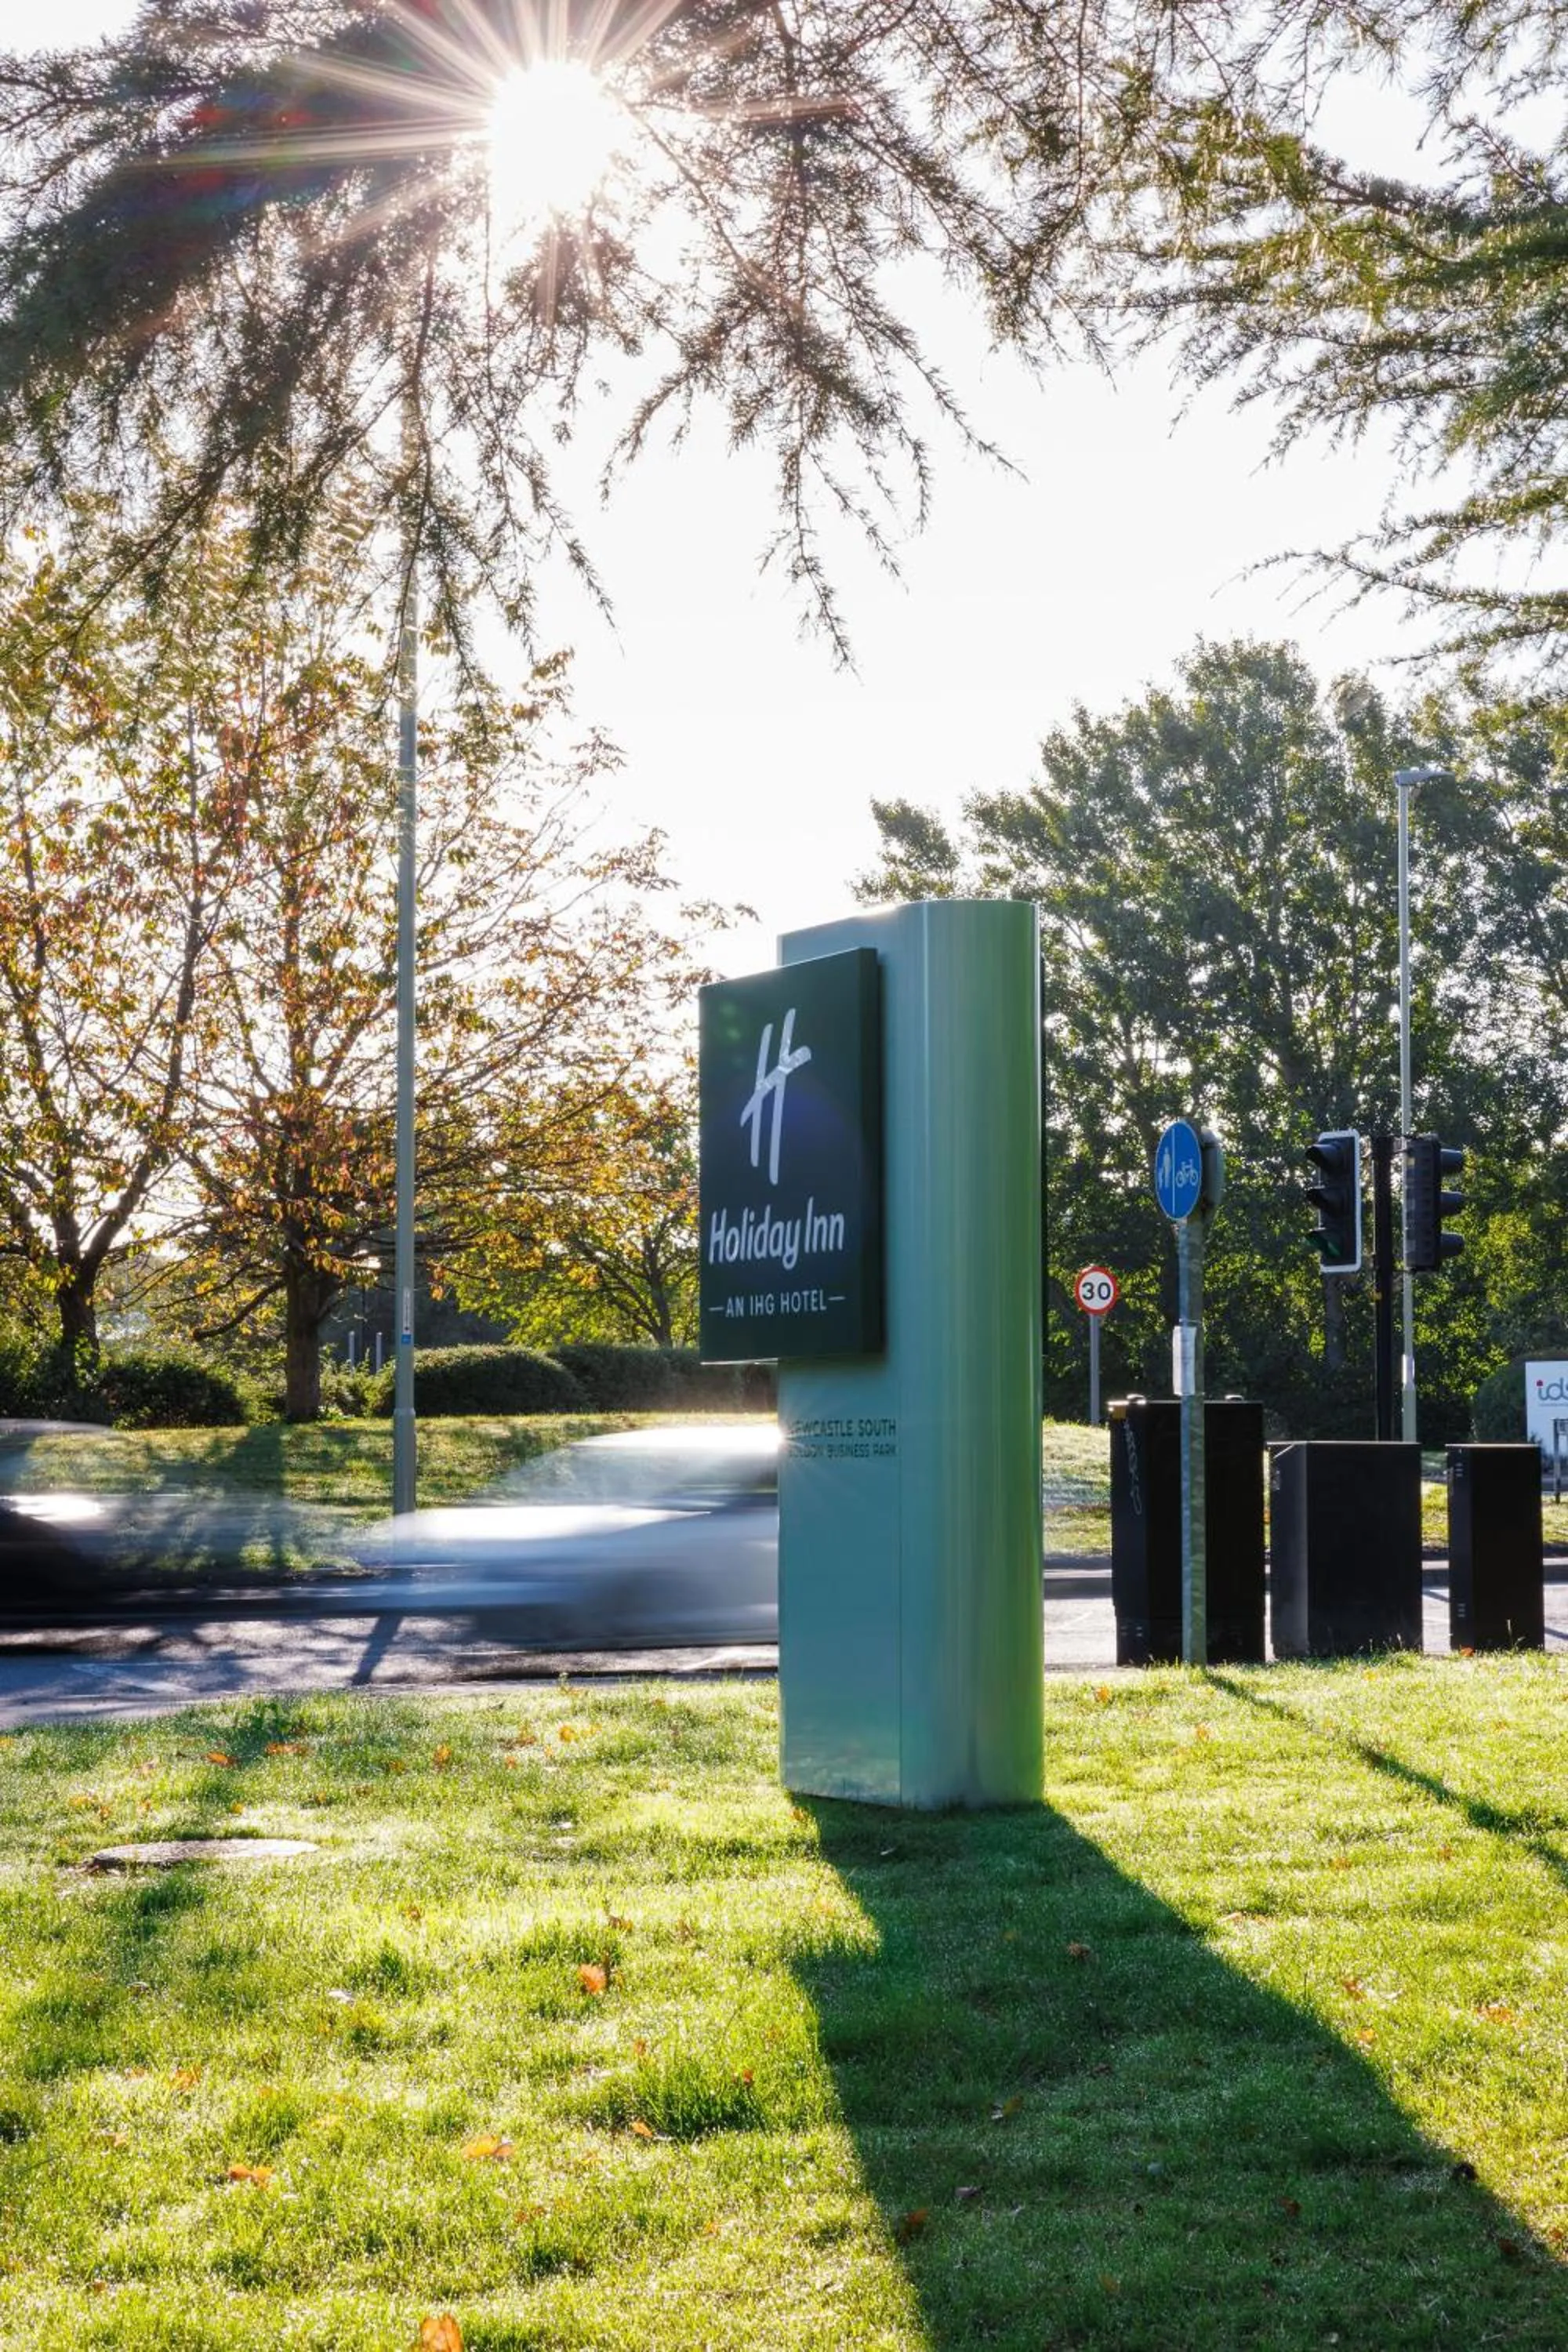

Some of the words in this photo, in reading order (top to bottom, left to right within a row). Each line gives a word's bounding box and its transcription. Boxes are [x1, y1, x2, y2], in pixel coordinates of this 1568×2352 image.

[709, 1204, 801, 1270] Holiday
[804, 1196, 845, 1254] Inn
[1082, 1282, 1111, 1301] 30
[725, 1296, 745, 1318] AN
[750, 1294, 775, 1316] IHG
[780, 1290, 827, 1314] HOTEL
[858, 1417, 897, 1437] SOUTH
[827, 1443, 870, 1458] BUSINESS
